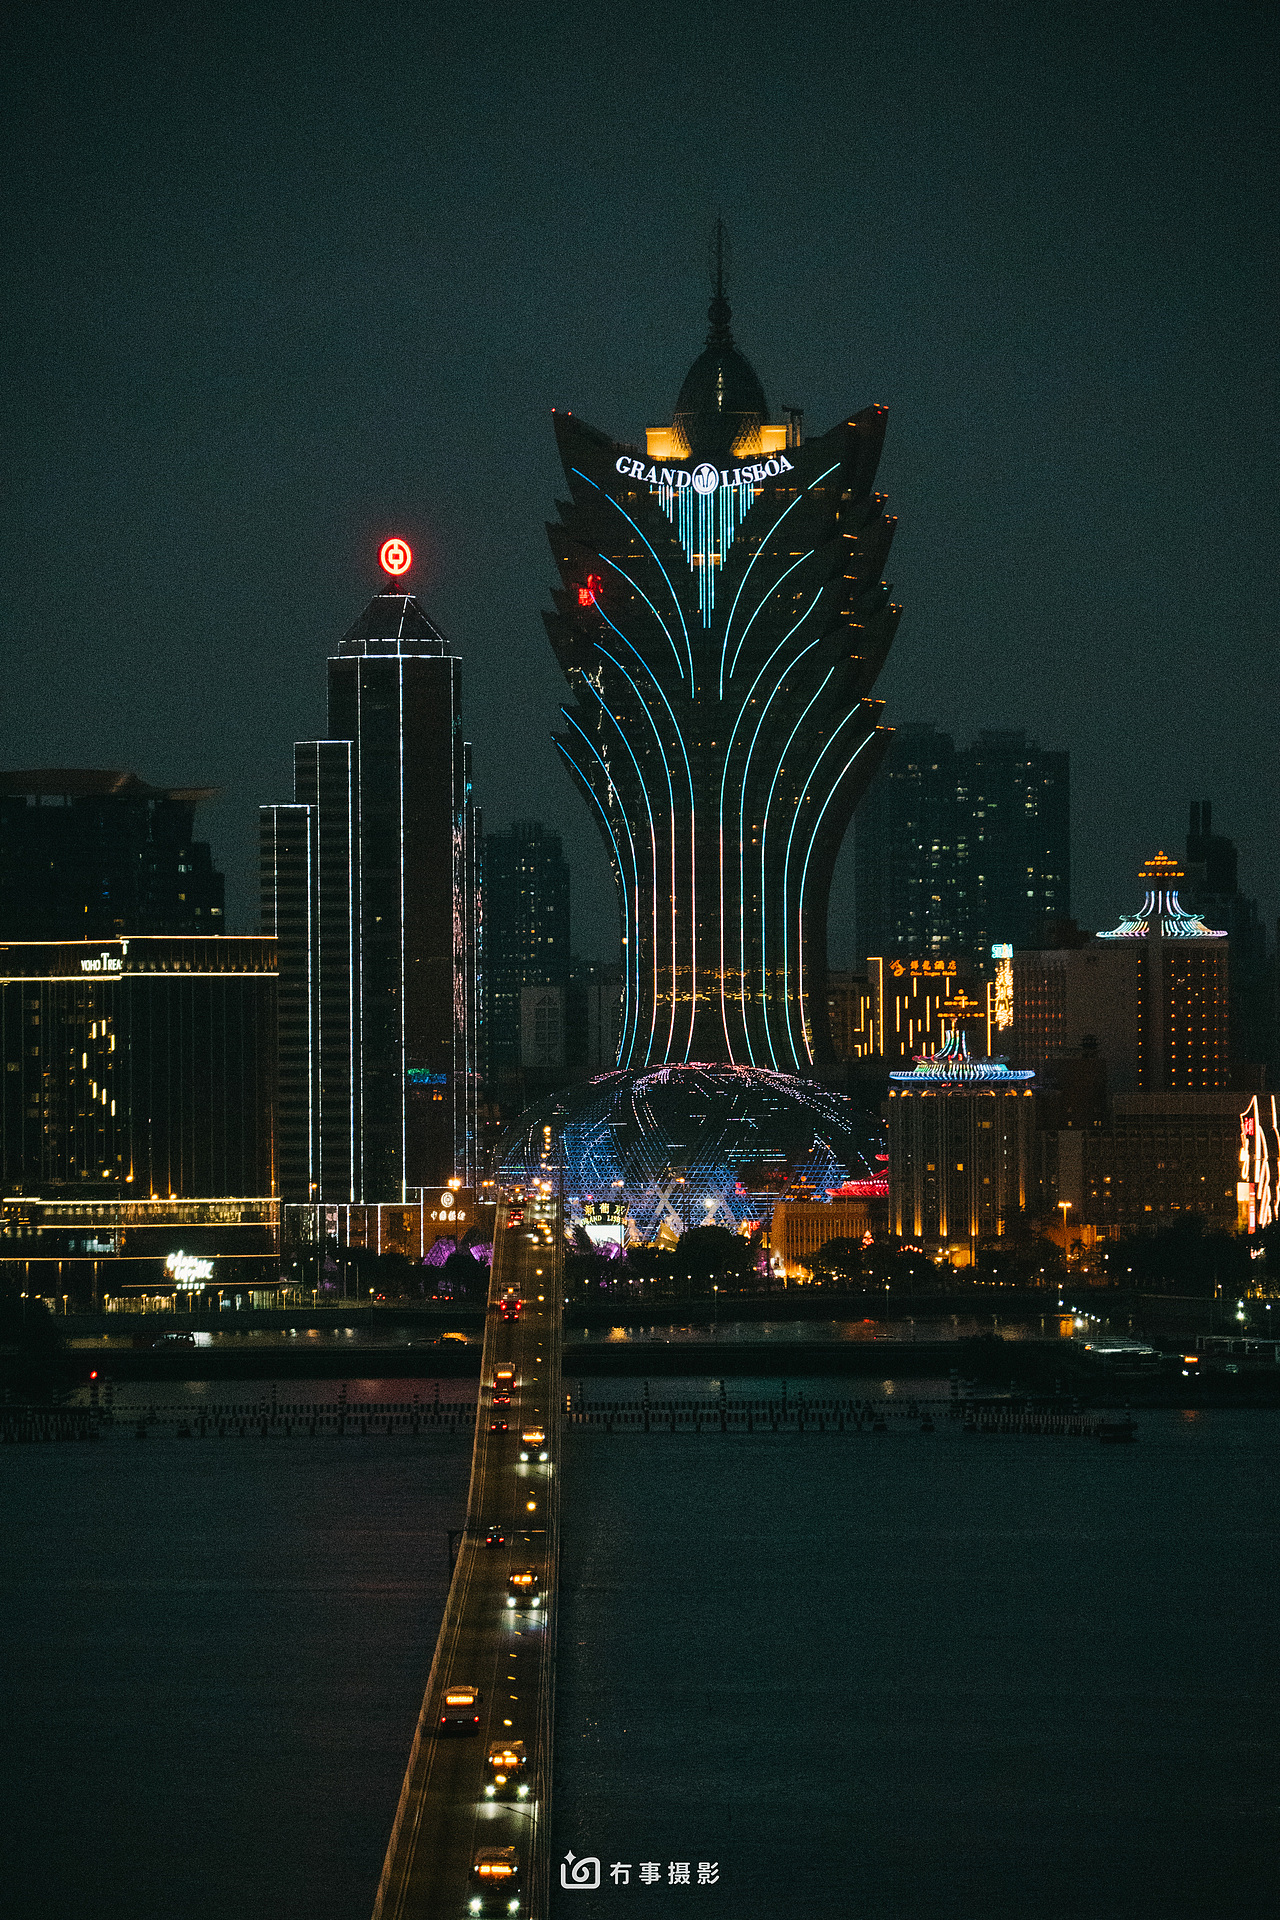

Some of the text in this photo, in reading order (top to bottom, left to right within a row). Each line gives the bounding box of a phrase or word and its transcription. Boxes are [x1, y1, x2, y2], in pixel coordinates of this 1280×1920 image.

[615, 455, 795, 488] GRAND LISBOA
[80, 959, 101, 971] YOHO
[584, 1202, 627, 1216] 新葡京
